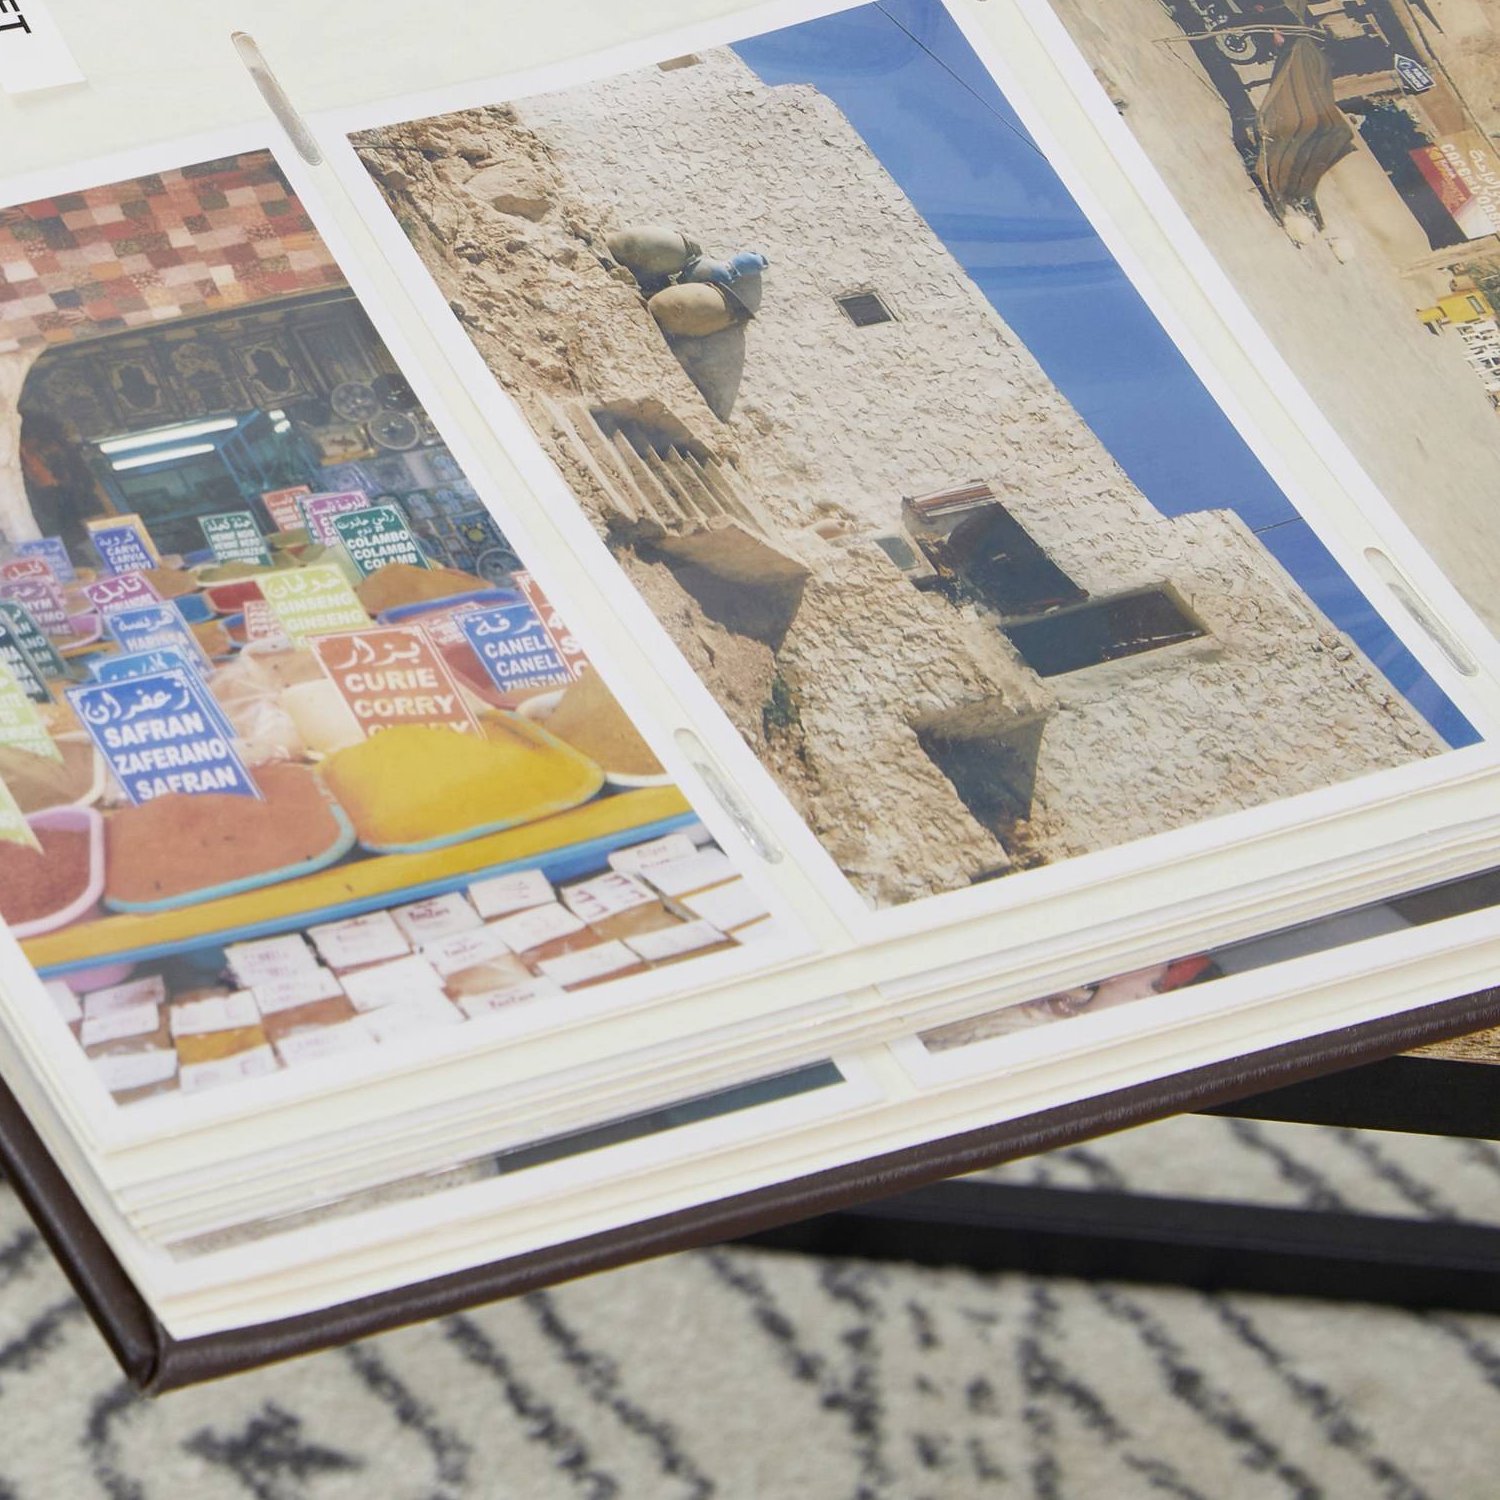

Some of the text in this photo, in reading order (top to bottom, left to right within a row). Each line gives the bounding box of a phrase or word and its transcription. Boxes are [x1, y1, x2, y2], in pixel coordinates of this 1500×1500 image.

[346, 530, 409, 550] COLAMBO
[355, 541, 416, 560] COLAMBA
[286, 610, 362, 633] GINSENG
[344, 667, 439, 693] CURIE
[353, 694, 455, 718] CORRY
[104, 712, 204, 749] SAFRAN
[113, 737, 227, 776] ZAFERANO
[135, 765, 238, 800] SAFRAN
